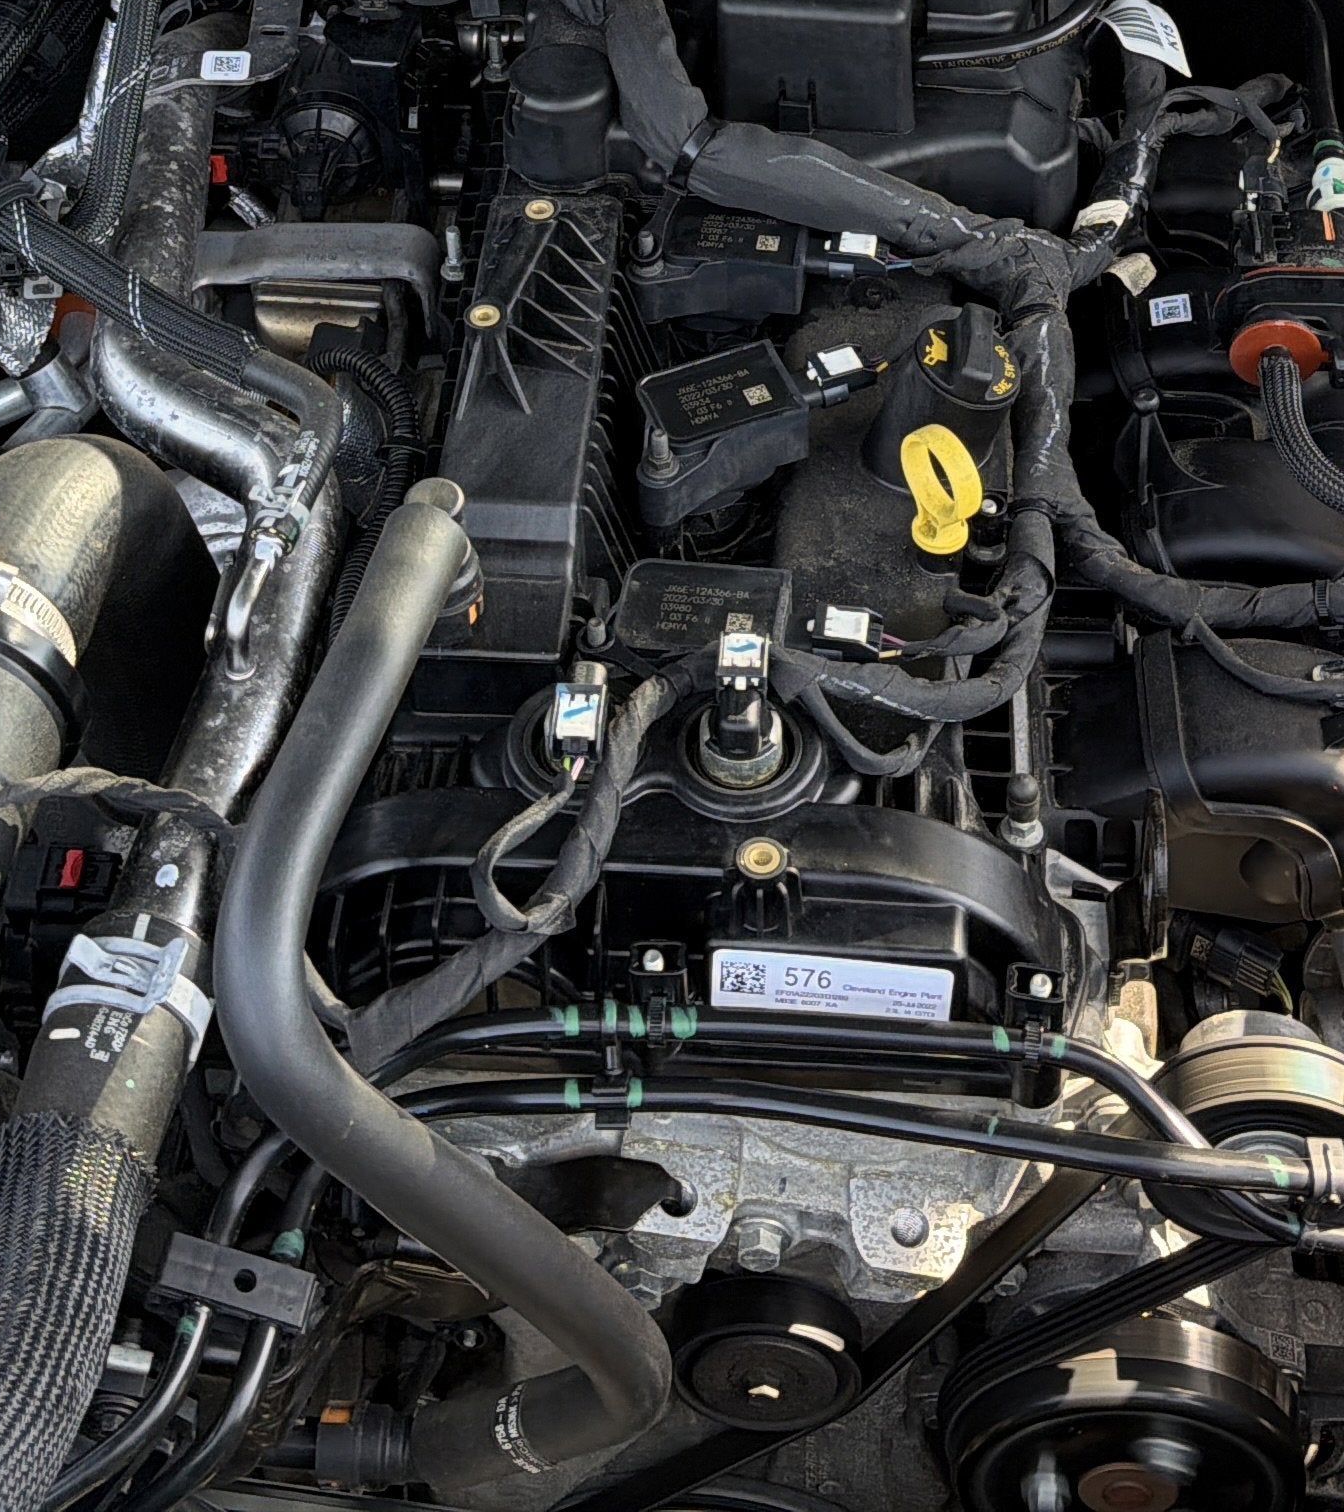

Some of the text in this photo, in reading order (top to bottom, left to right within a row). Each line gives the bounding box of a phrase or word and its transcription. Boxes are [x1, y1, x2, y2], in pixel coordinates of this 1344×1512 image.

[992, 345, 1016, 395] SAE 5W-30
[679, 382, 733, 404] 2022/03/30
[662, 593, 724, 606] 2022/03/30
[665, 585, 750, 599] JX6E-12A366-BA
[784, 966, 833, 989] 576
[842, 983, 944, 1001] Cleveland Engine Plant
